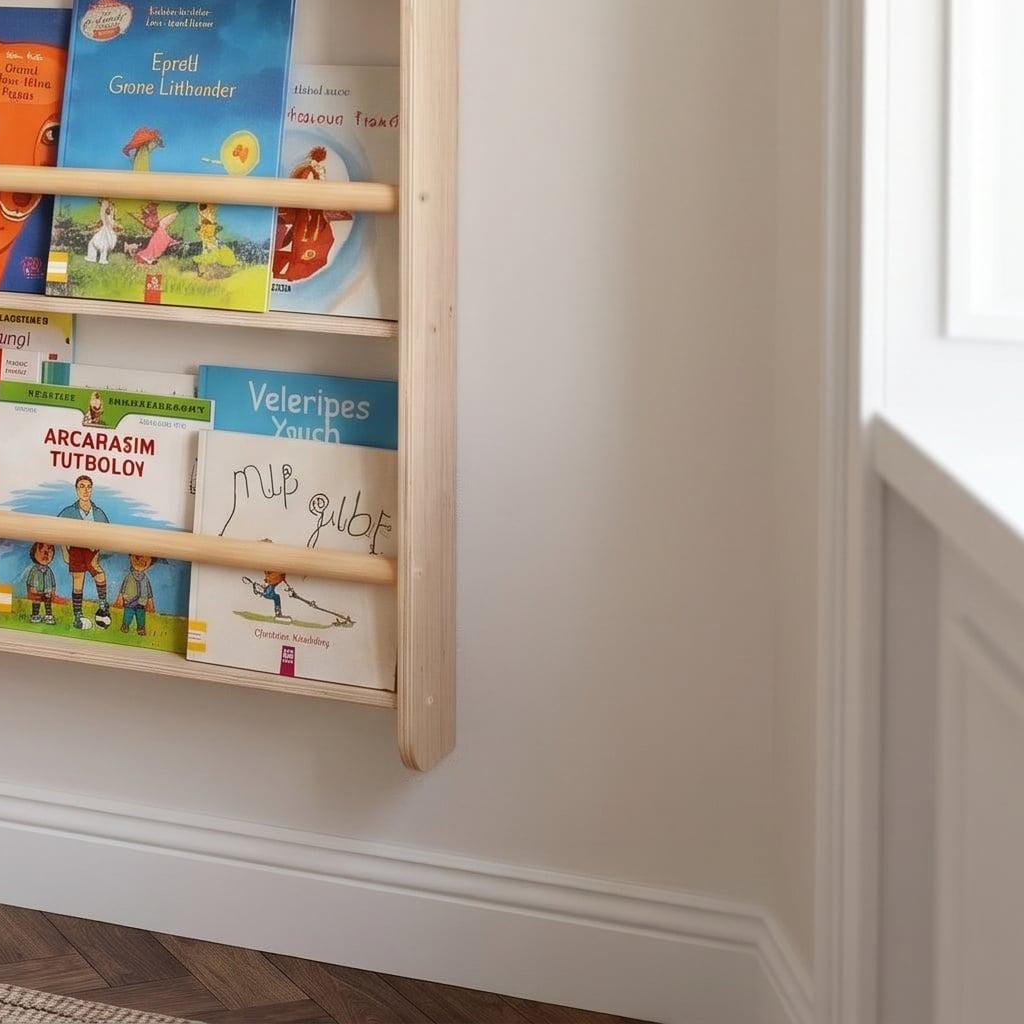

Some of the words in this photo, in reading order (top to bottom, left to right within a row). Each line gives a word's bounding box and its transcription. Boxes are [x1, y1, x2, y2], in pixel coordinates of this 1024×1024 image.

[248, 380, 371, 423] Veleripes
[43, 427, 156, 456] ARCARASIM
[49, 450, 146, 478] TUTBOLOY
